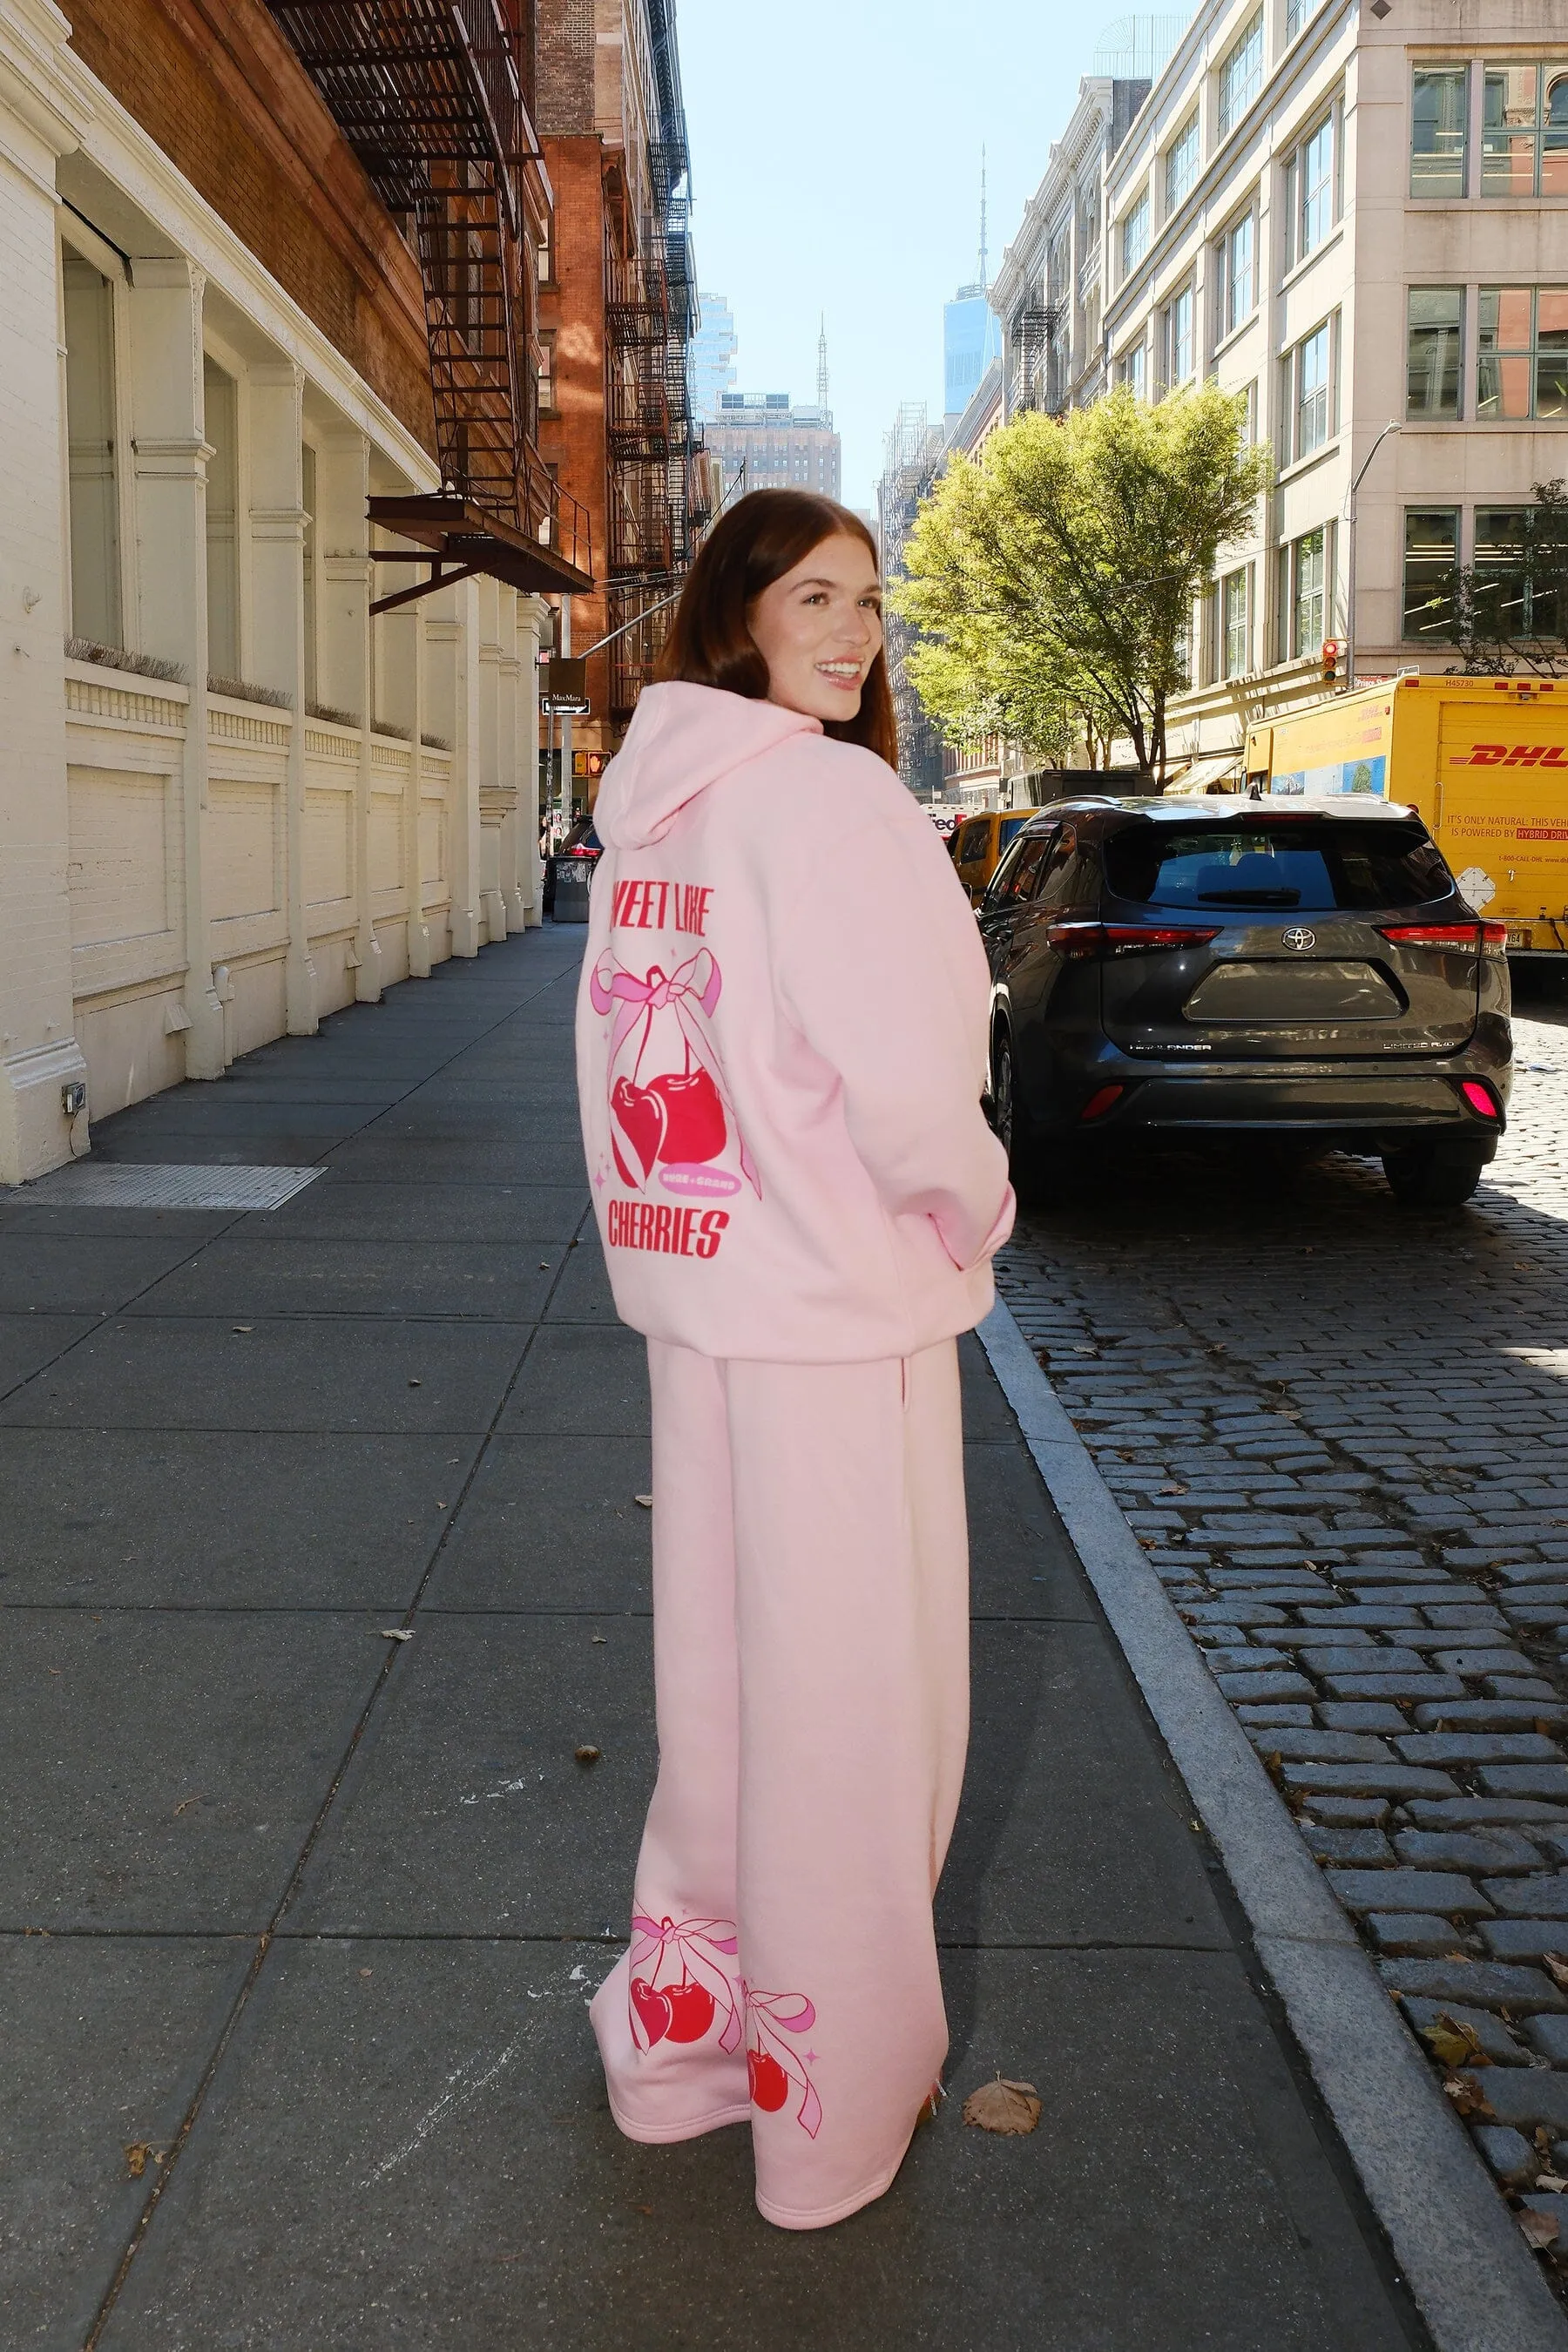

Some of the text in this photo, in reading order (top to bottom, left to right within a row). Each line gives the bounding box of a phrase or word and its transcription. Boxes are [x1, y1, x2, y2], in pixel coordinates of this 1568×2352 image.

[1467, 744, 1568, 768] DHL
[1447, 815, 1462, 824] IT'S
[1464, 816, 1485, 825] ONLY
[1531, 817, 1548, 827] THIS
[1461, 828, 1501, 837] POWERED
[1517, 829, 1549, 839] HYBRID
[608, 1199, 730, 1260] CHERRIES
